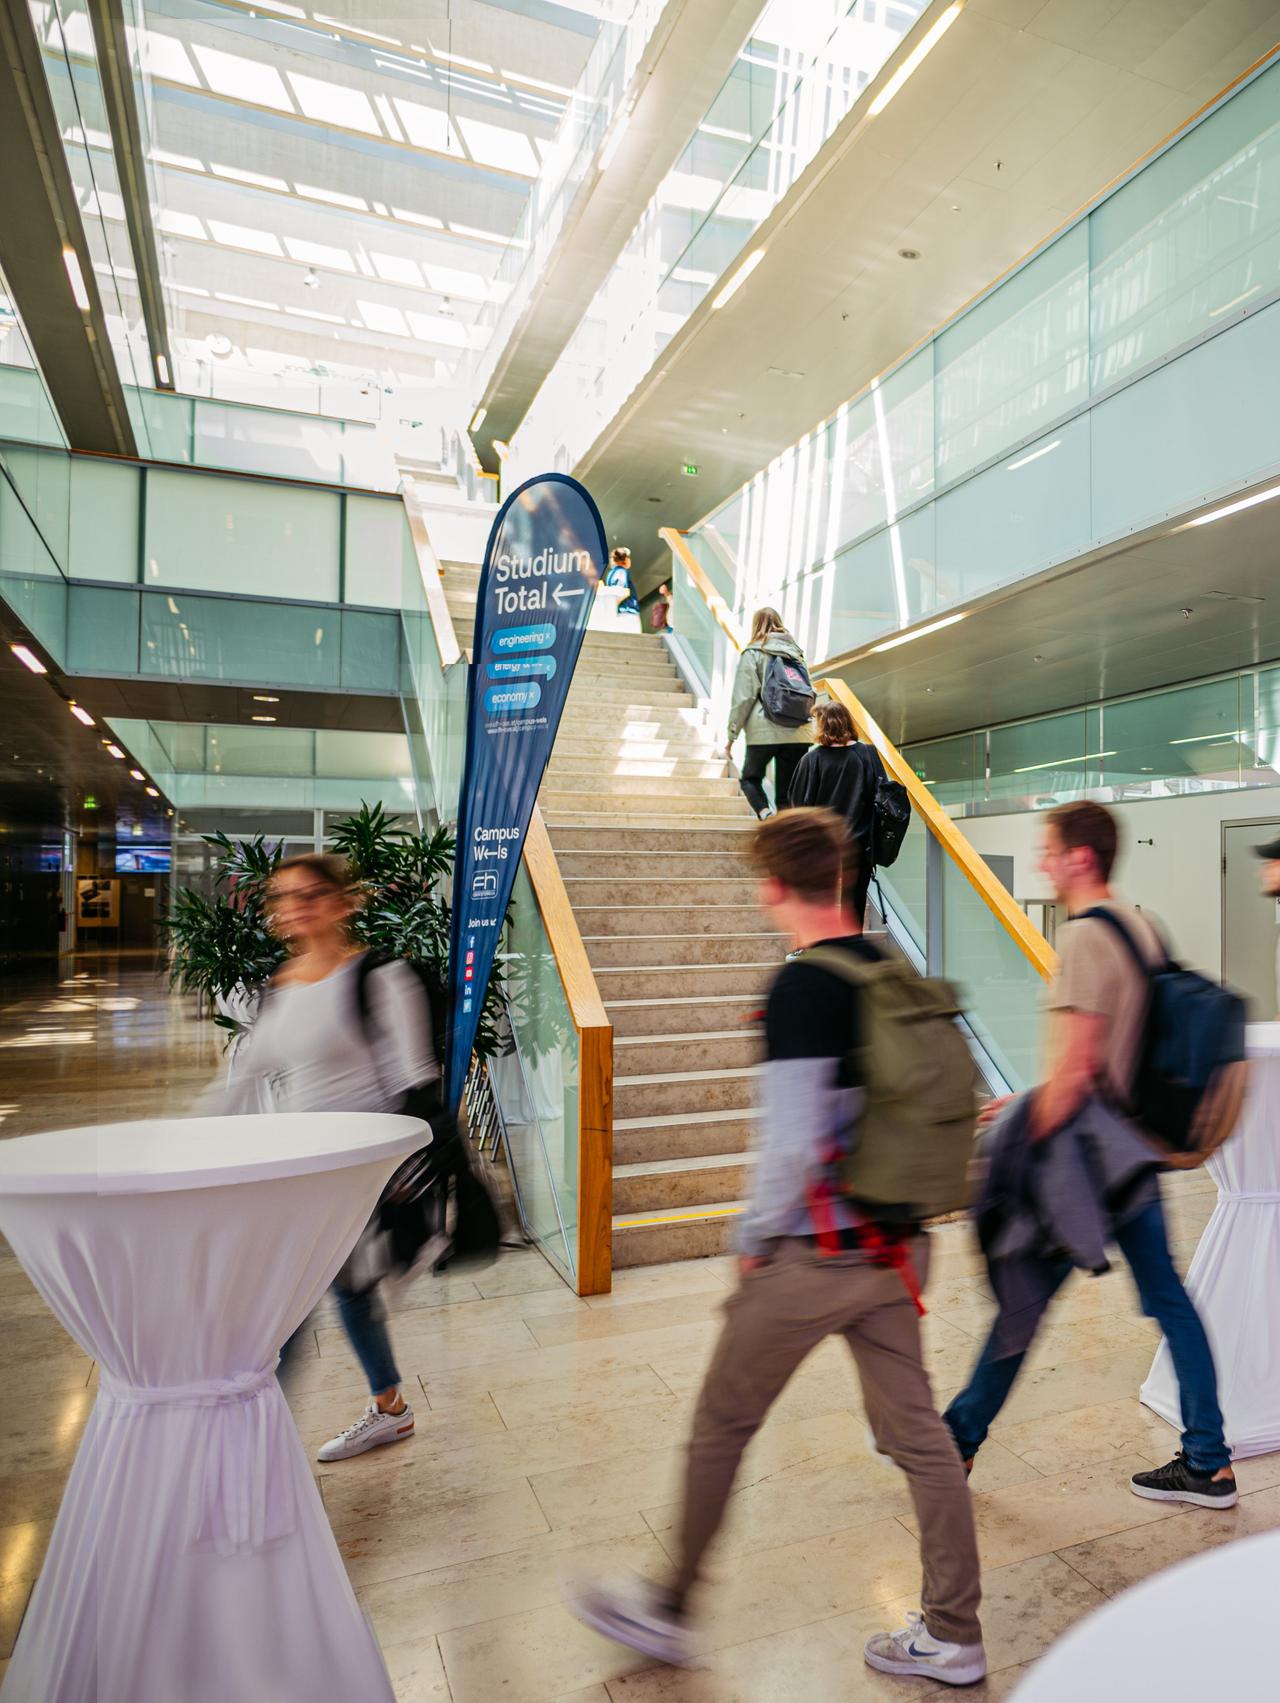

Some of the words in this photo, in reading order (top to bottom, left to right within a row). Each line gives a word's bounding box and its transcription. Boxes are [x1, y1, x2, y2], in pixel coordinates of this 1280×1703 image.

[496, 546, 591, 582] Studium
[495, 581, 548, 615] Total
[498, 631, 545, 648] engineering
[491, 691, 528, 704] economy
[474, 826, 520, 844] Campus
[468, 918, 481, 929] Join
[481, 918, 489, 927] us
